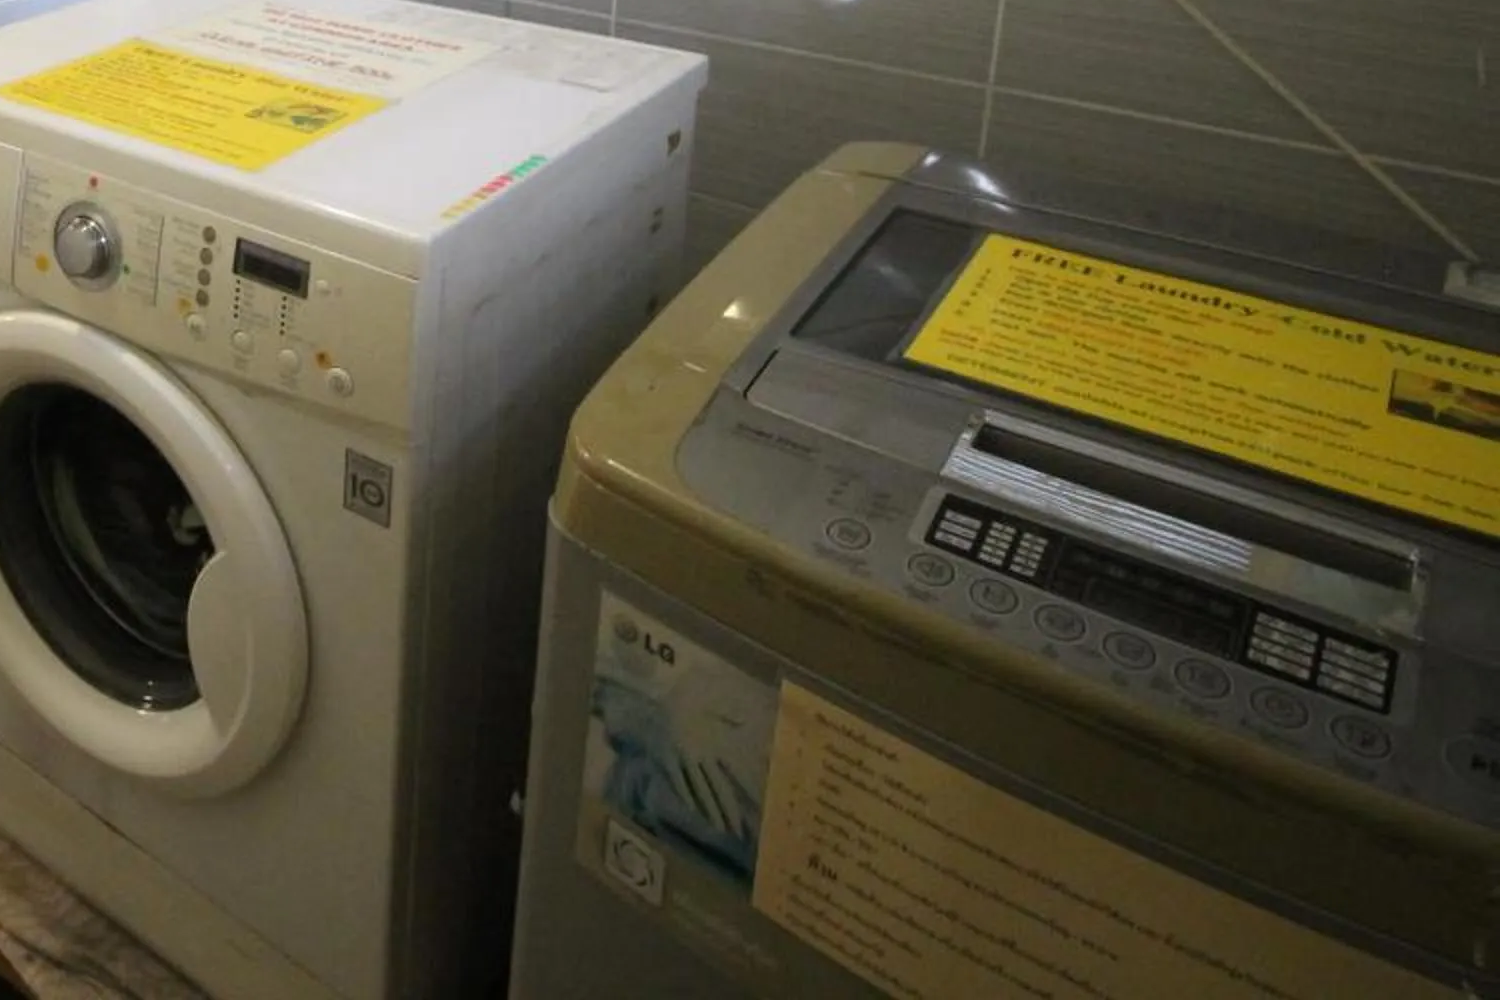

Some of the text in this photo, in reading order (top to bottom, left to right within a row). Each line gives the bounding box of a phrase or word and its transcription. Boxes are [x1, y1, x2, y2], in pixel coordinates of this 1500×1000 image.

[1009, 247, 1105, 279] FREE
[1113, 271, 1261, 319] Laundry
[1377, 337, 1499, 380] Water
[643, 633, 676, 667] LG
